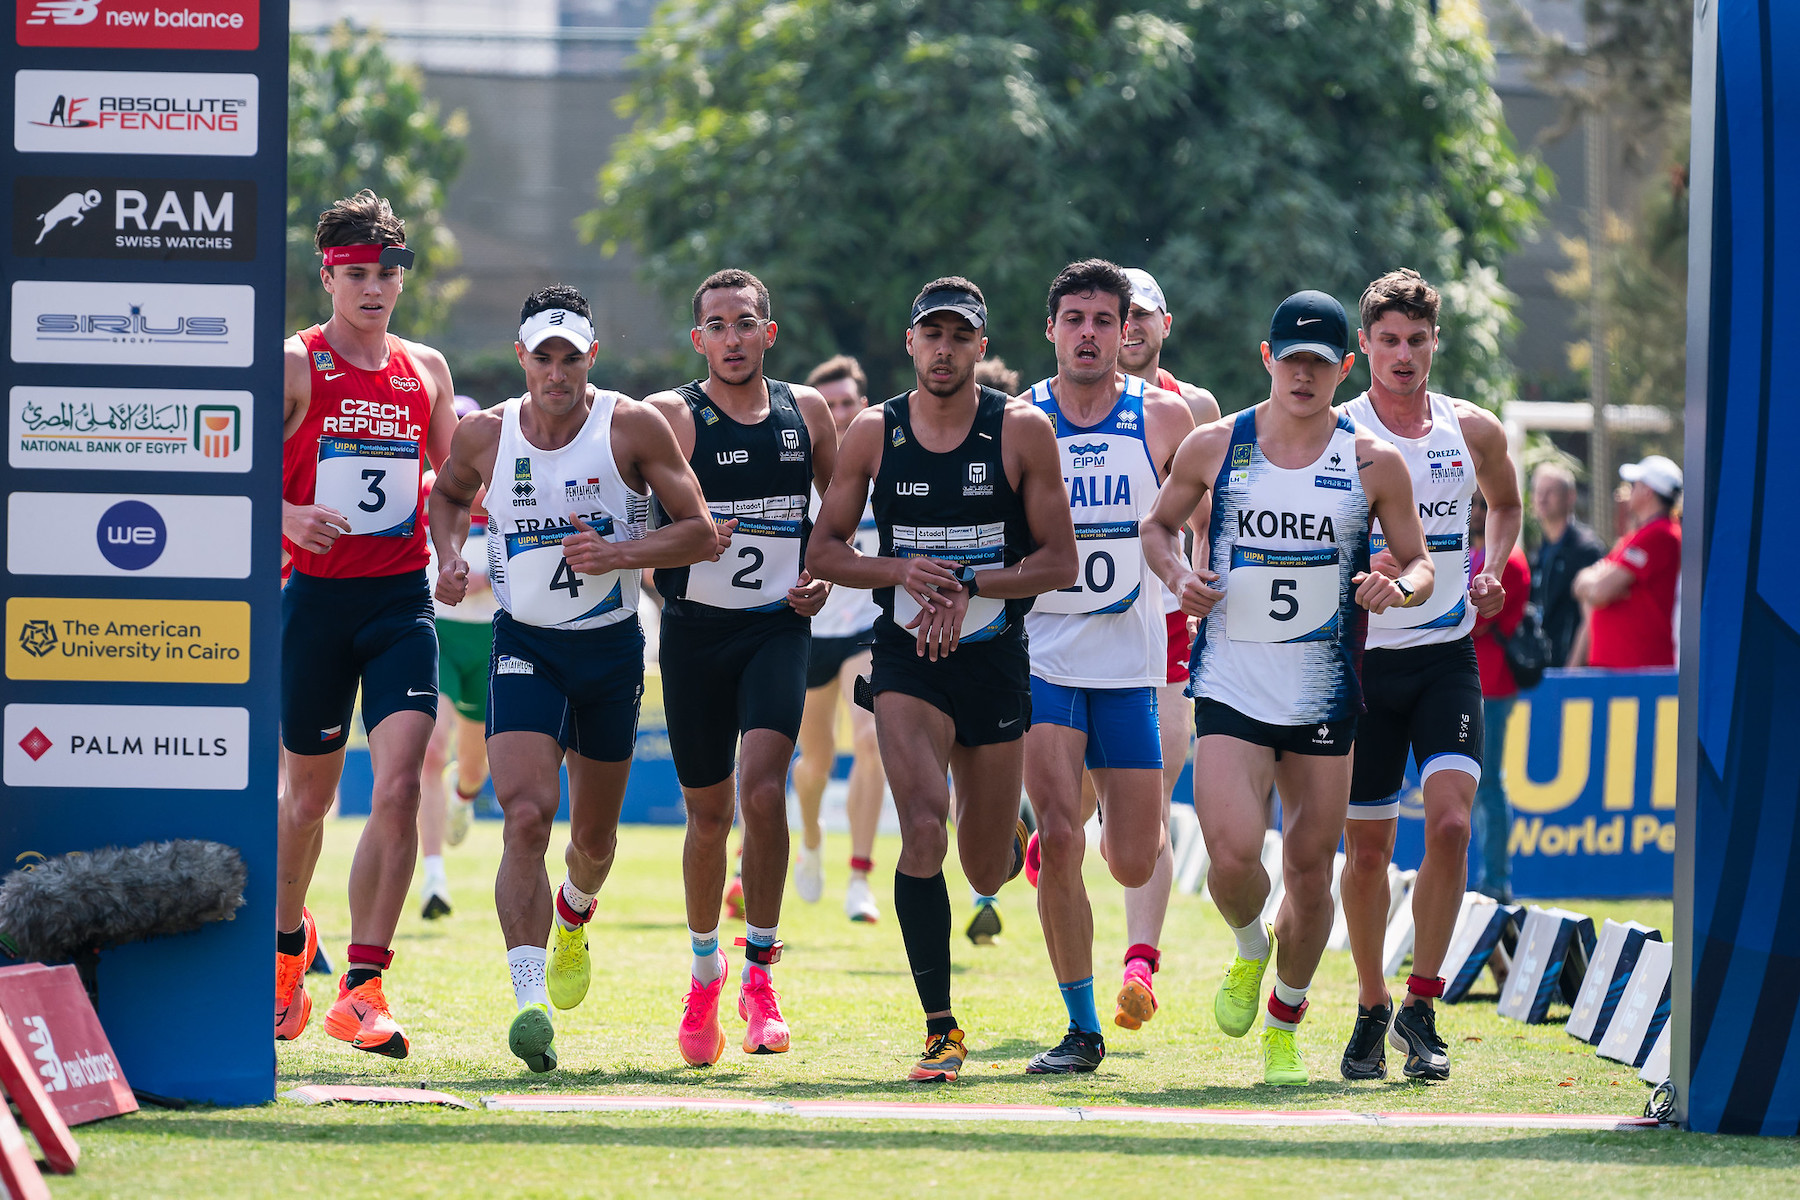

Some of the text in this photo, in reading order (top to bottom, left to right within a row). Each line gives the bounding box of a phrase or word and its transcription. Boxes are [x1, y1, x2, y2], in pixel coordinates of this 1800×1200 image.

[105, 8, 245, 29] new balance
[100, 112, 238, 131] FENCING
[115, 189, 234, 232] RAM
[115, 235, 233, 249] SWISS WATCHES
[340, 398, 410, 421] CZECH
[322, 416, 422, 440] REPUBLIC
[1116, 421, 1138, 431] errea
[21, 440, 188, 454] NATIONAL BANK OF EGYPT
[334, 442, 357, 451] UIPM
[1426, 449, 1461, 459] OREZZA
[716, 449, 749, 466] we
[1073, 455, 1105, 467] FIPM
[1431, 467, 1464, 479] PENTATHLON
[357, 468, 386, 513] 3
[565, 484, 601, 497] PENTATHLON
[895, 482, 930, 496] we
[512, 498, 537, 507] errea
[739, 521, 771, 531] Pentathlon
[1237, 509, 1336, 543] KOREA
[107, 526, 157, 545] we
[517, 535, 539, 545] UIPM
[1243, 551, 1264, 561] UIPM
[731, 546, 764, 590] 2
[549, 556, 584, 599] 4
[1268, 578, 1299, 622] 5
[62, 620, 201, 637] The American
[61, 642, 240, 661] University in Cairo
[71, 735, 228, 757] PALM HILLS
[1507, 815, 1625, 857] World
[62, 1060, 88, 1089] new
